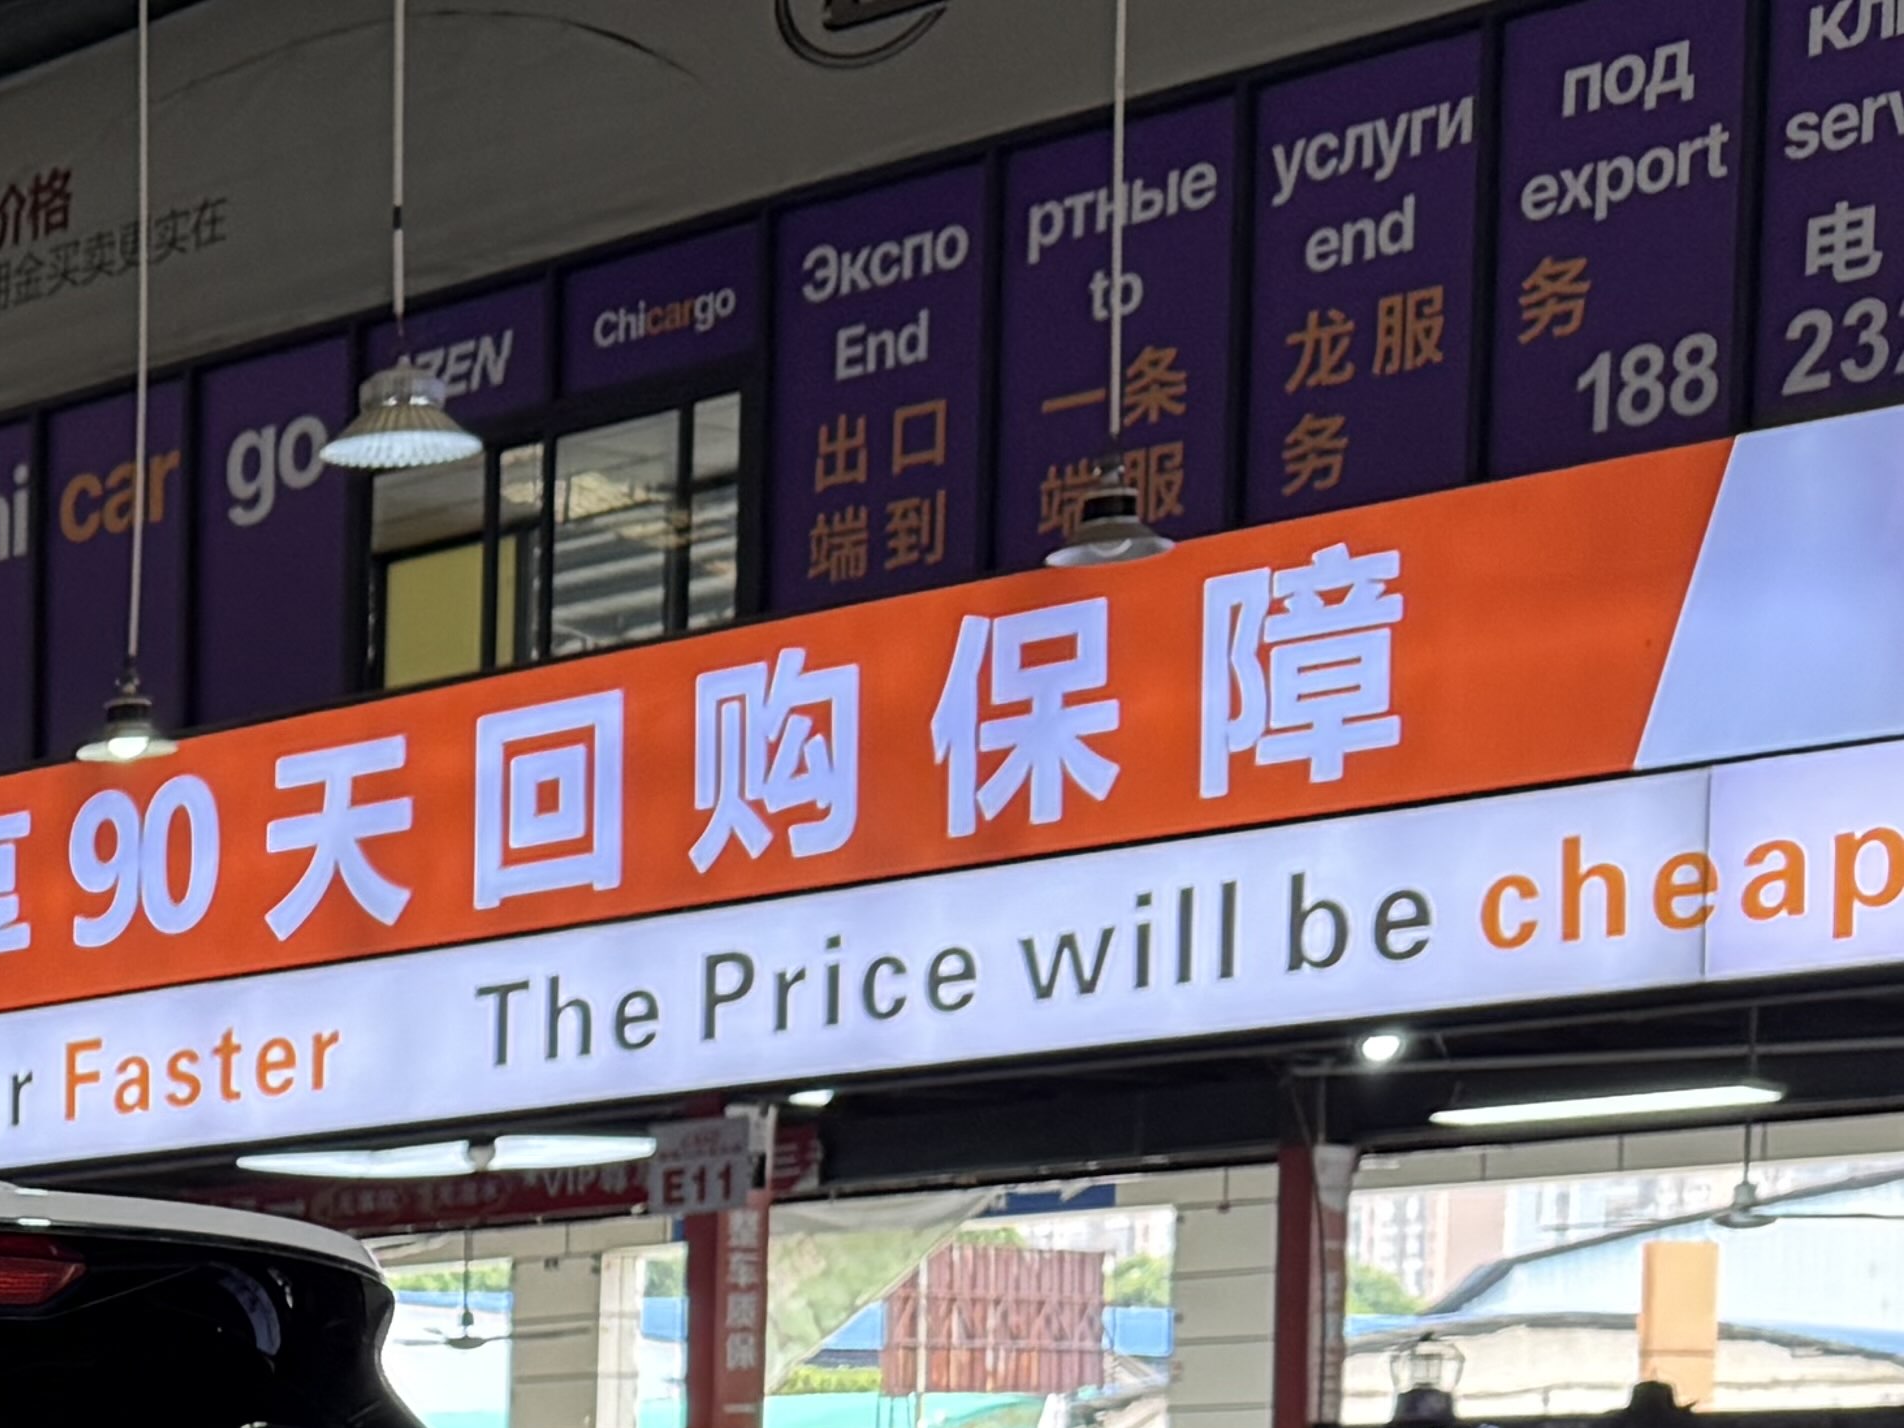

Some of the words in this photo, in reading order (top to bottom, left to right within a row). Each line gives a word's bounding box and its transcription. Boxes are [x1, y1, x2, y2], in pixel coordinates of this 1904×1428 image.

[1271, 95, 1475, 207] услуги
[1561, 39, 1695, 118] под
[835, 308, 930, 381] End
[1088, 268, 1144, 321] to
[1304, 194, 1416, 272] end
[1520, 122, 1730, 221] export
[1803, 200, 1883, 284] 电
[593, 281, 737, 352] Chicargo
[1575, 332, 1720, 434] 188
[63, 1024, 341, 1121] Faster
[477, 975, 660, 1068] The
[701, 935, 978, 1042] Price
[1021, 882, 1238, 1002] will
[1288, 871, 1433, 971] be
[661, 1162, 733, 1207] E11
